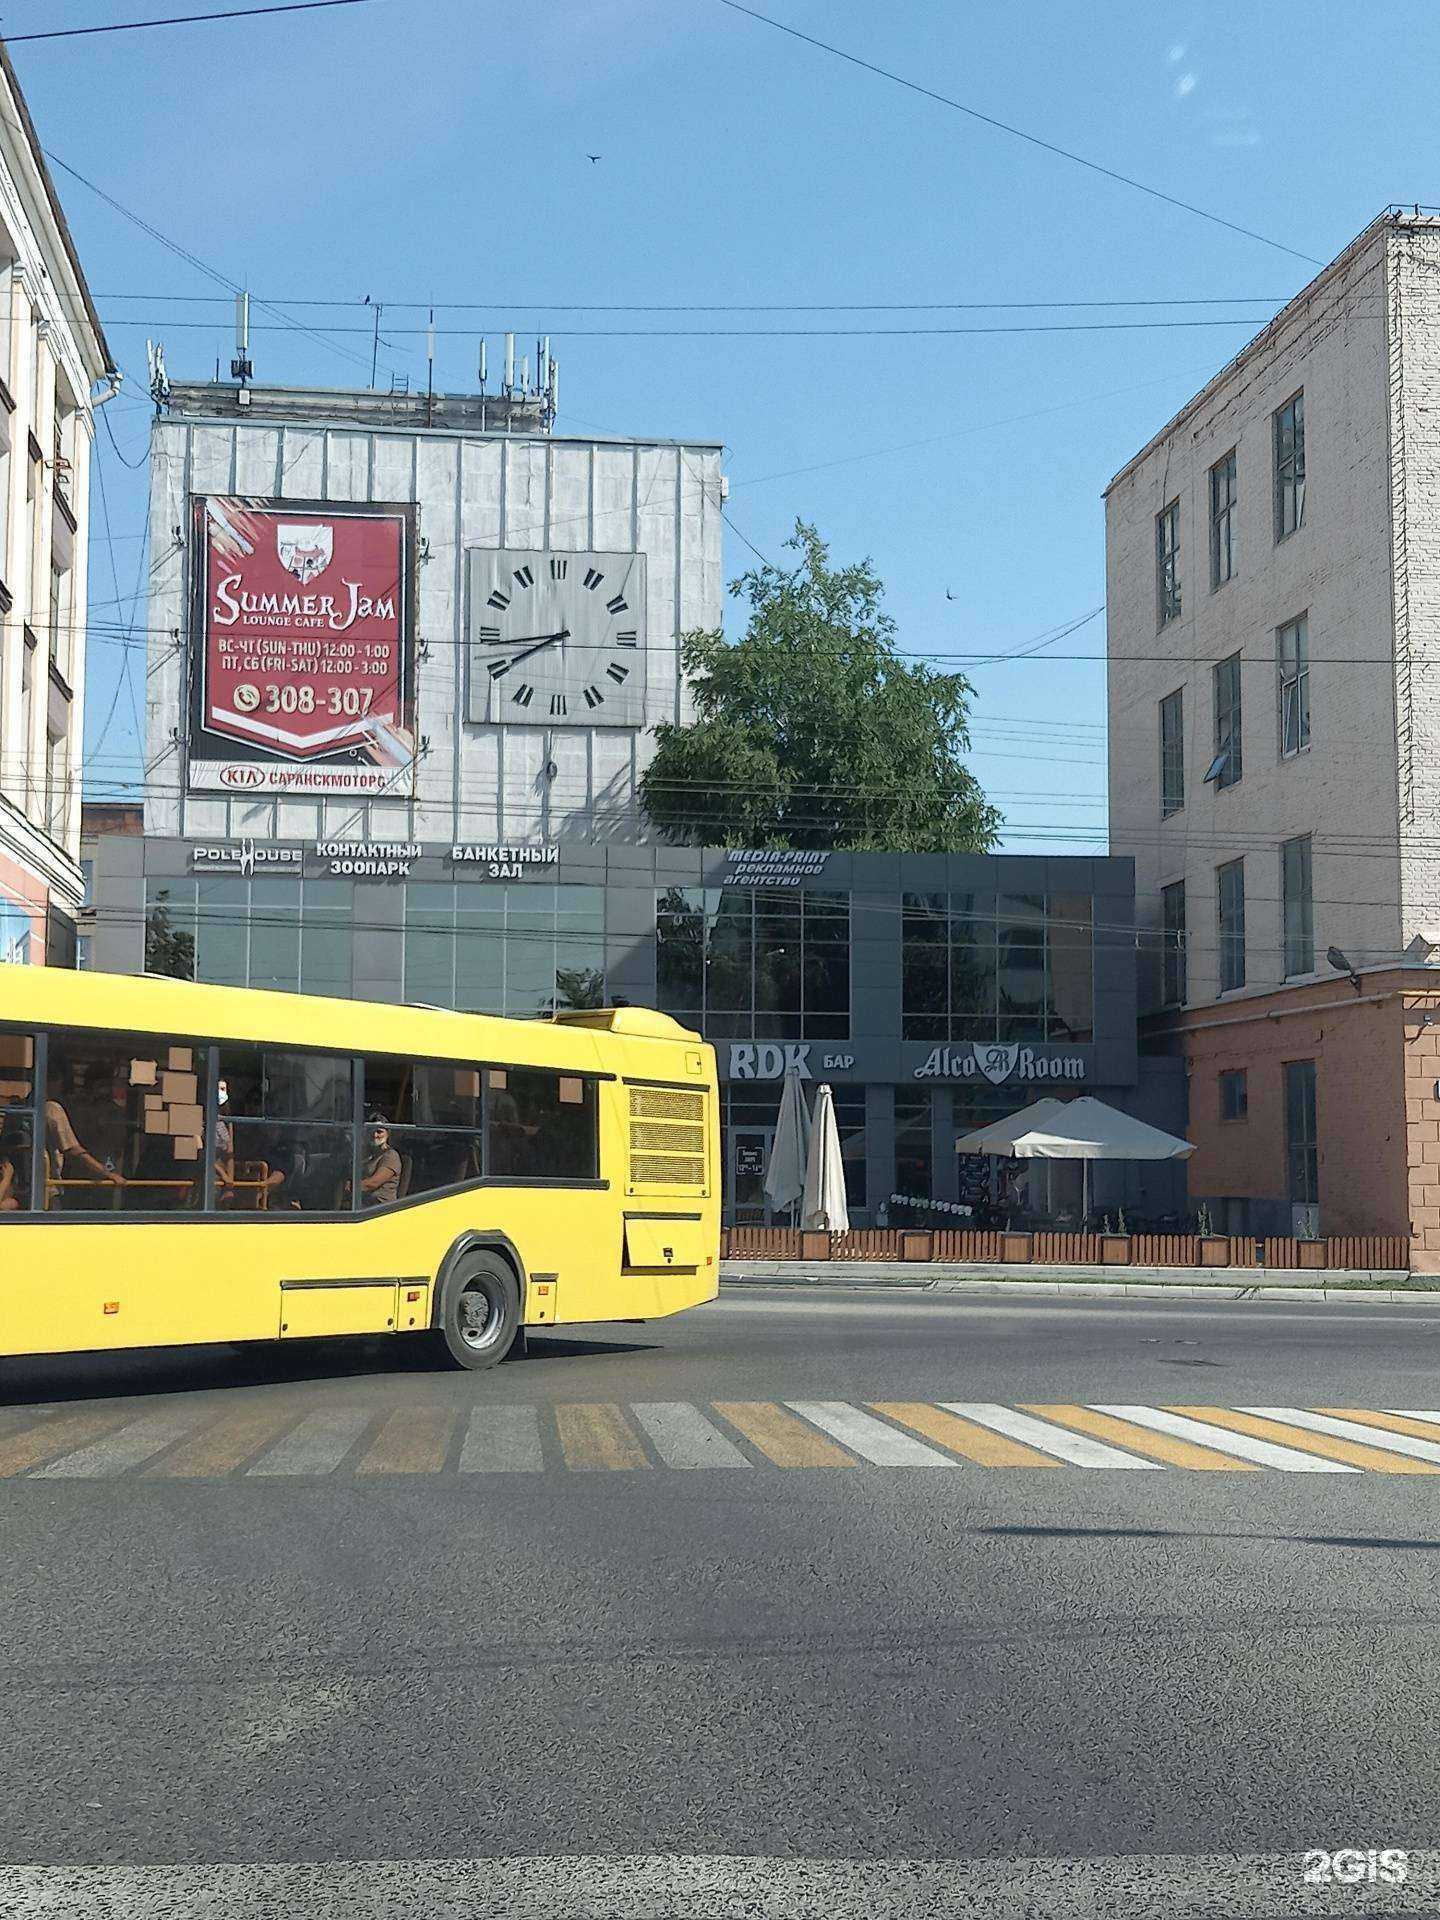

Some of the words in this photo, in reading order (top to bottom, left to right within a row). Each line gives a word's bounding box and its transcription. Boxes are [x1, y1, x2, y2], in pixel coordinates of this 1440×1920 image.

[213, 573, 338, 626] SUMMER
[328, 577, 396, 631] JAM
[243, 615, 292, 626] LOUNGE
[295, 617, 325, 628] CAFE
[257, 640, 321, 657] (SUN-THU)
[324, 643, 355, 657] 12:00
[366, 645, 390, 659] 1:00
[261, 657, 318, 674] (FRI-SAT)
[321, 660, 352, 674] 12:00
[361, 661, 388, 675] 3:00
[265, 684, 374, 716] 308-307
[226, 769, 258, 785] KIA
[269, 771, 387, 789] САРАНСКМОТОРС
[316, 842, 422, 858] КОНТАКТНЫЙ
[452, 844, 559, 863] БАНКЕТНЫЙ
[727, 849, 831, 863] MEDIA-PRINT
[331, 860, 411, 876] ЗООПАРК
[488, 863, 523, 878] ЗАЛ
[734, 863, 823, 875] рекламное
[723, 874, 801, 886] агентство
[729, 1044, 812, 1079] RDK
[823, 1054, 855, 1069] БАР
[914, 1047, 976, 1079] Alco
[1018, 1048, 1086, 1080] Room
